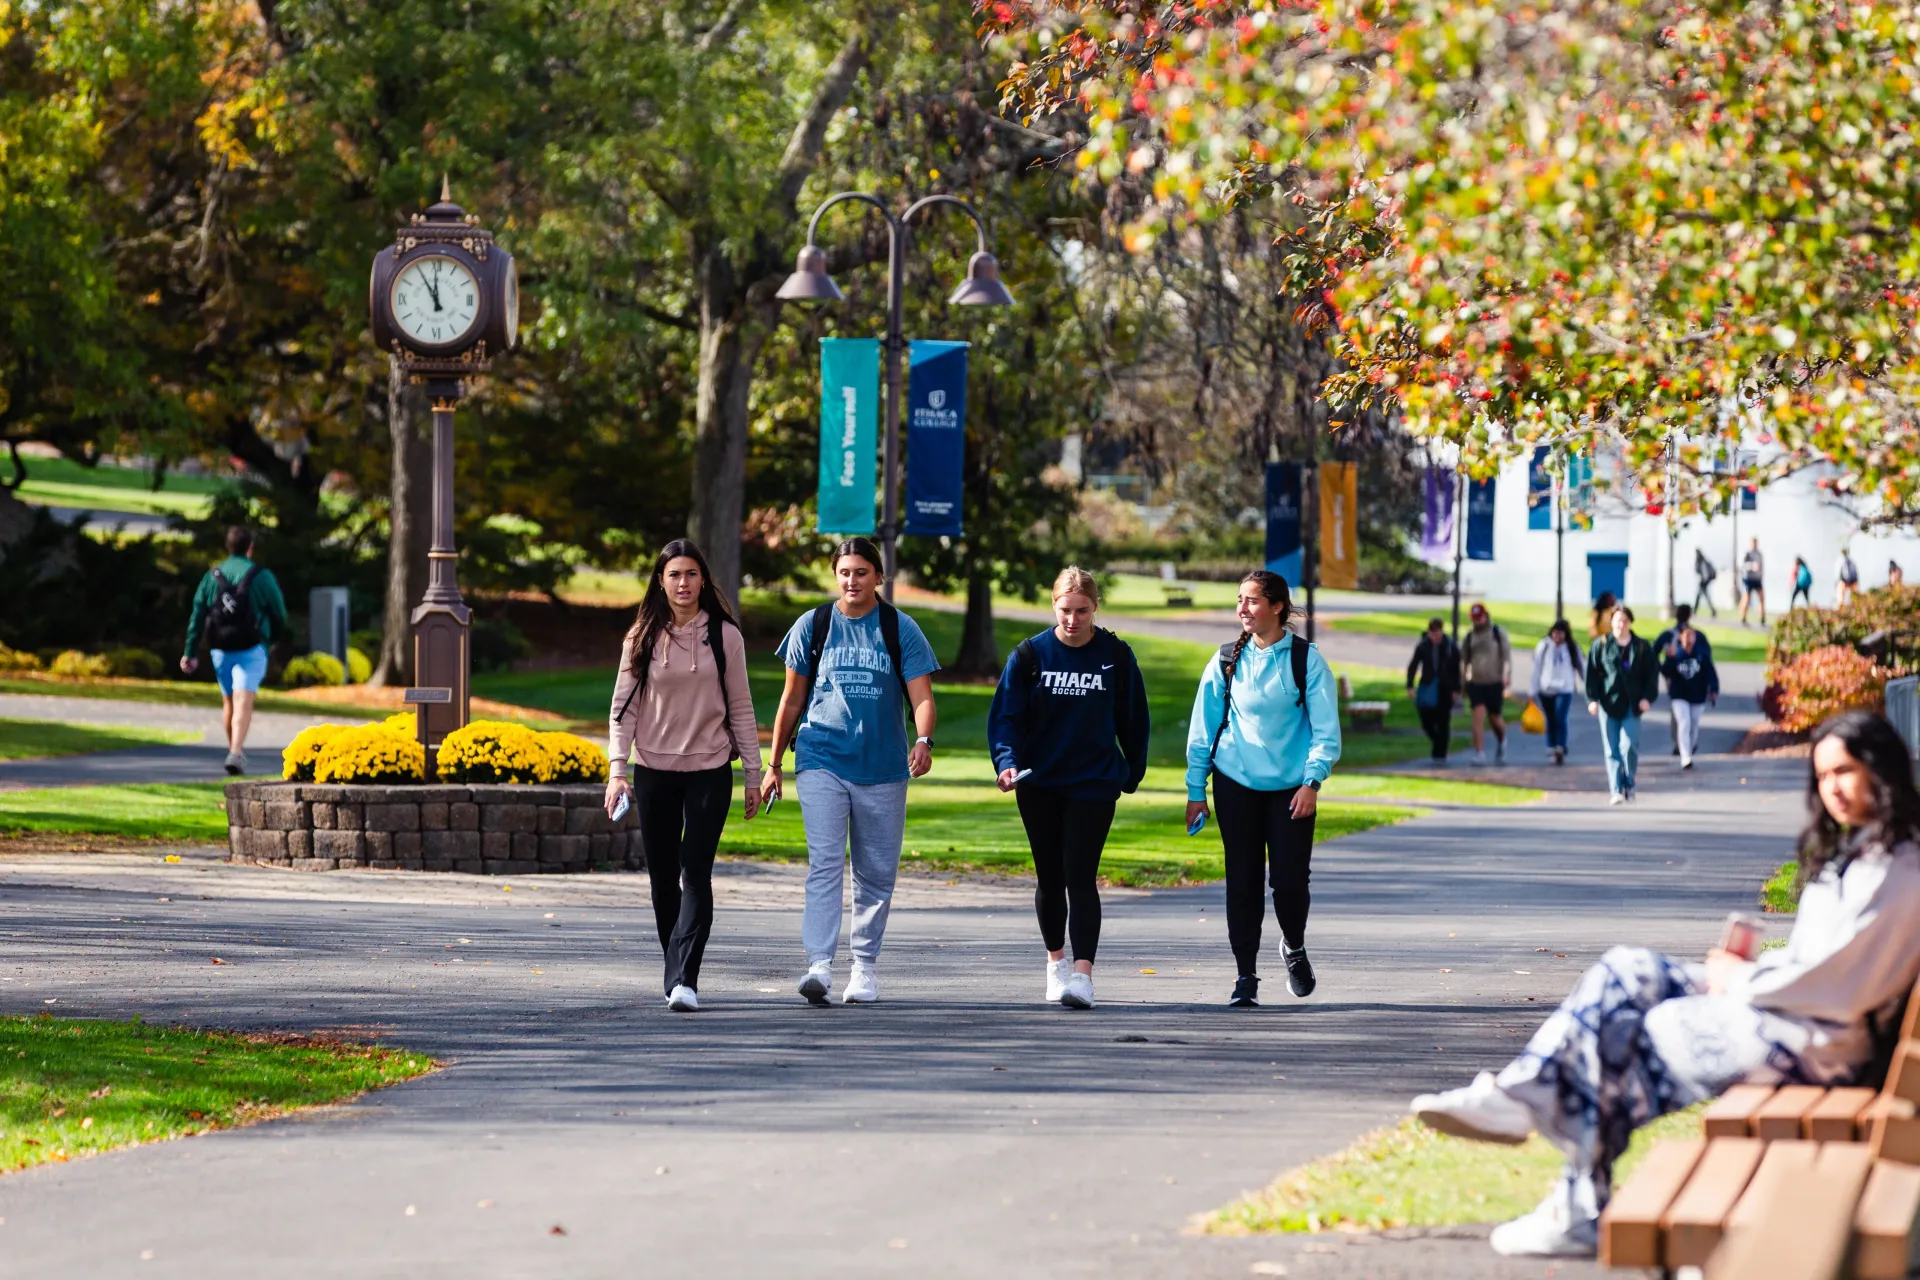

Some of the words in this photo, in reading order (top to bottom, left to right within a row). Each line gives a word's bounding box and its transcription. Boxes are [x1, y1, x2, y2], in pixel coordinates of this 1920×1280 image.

[398, 293, 407, 306] IX
[431, 327, 442, 340] VI
[841, 386, 857, 448] Yourself
[914, 408, 957, 418] ITHACA
[820, 646, 856, 668] RTLE
[858, 647, 891, 675] BEACH
[835, 673, 849, 681] EST.
[851, 673, 868, 681] 1938
[844, 685, 883, 695] CAROLINA
[1052, 687, 1087, 696] SOCCER
